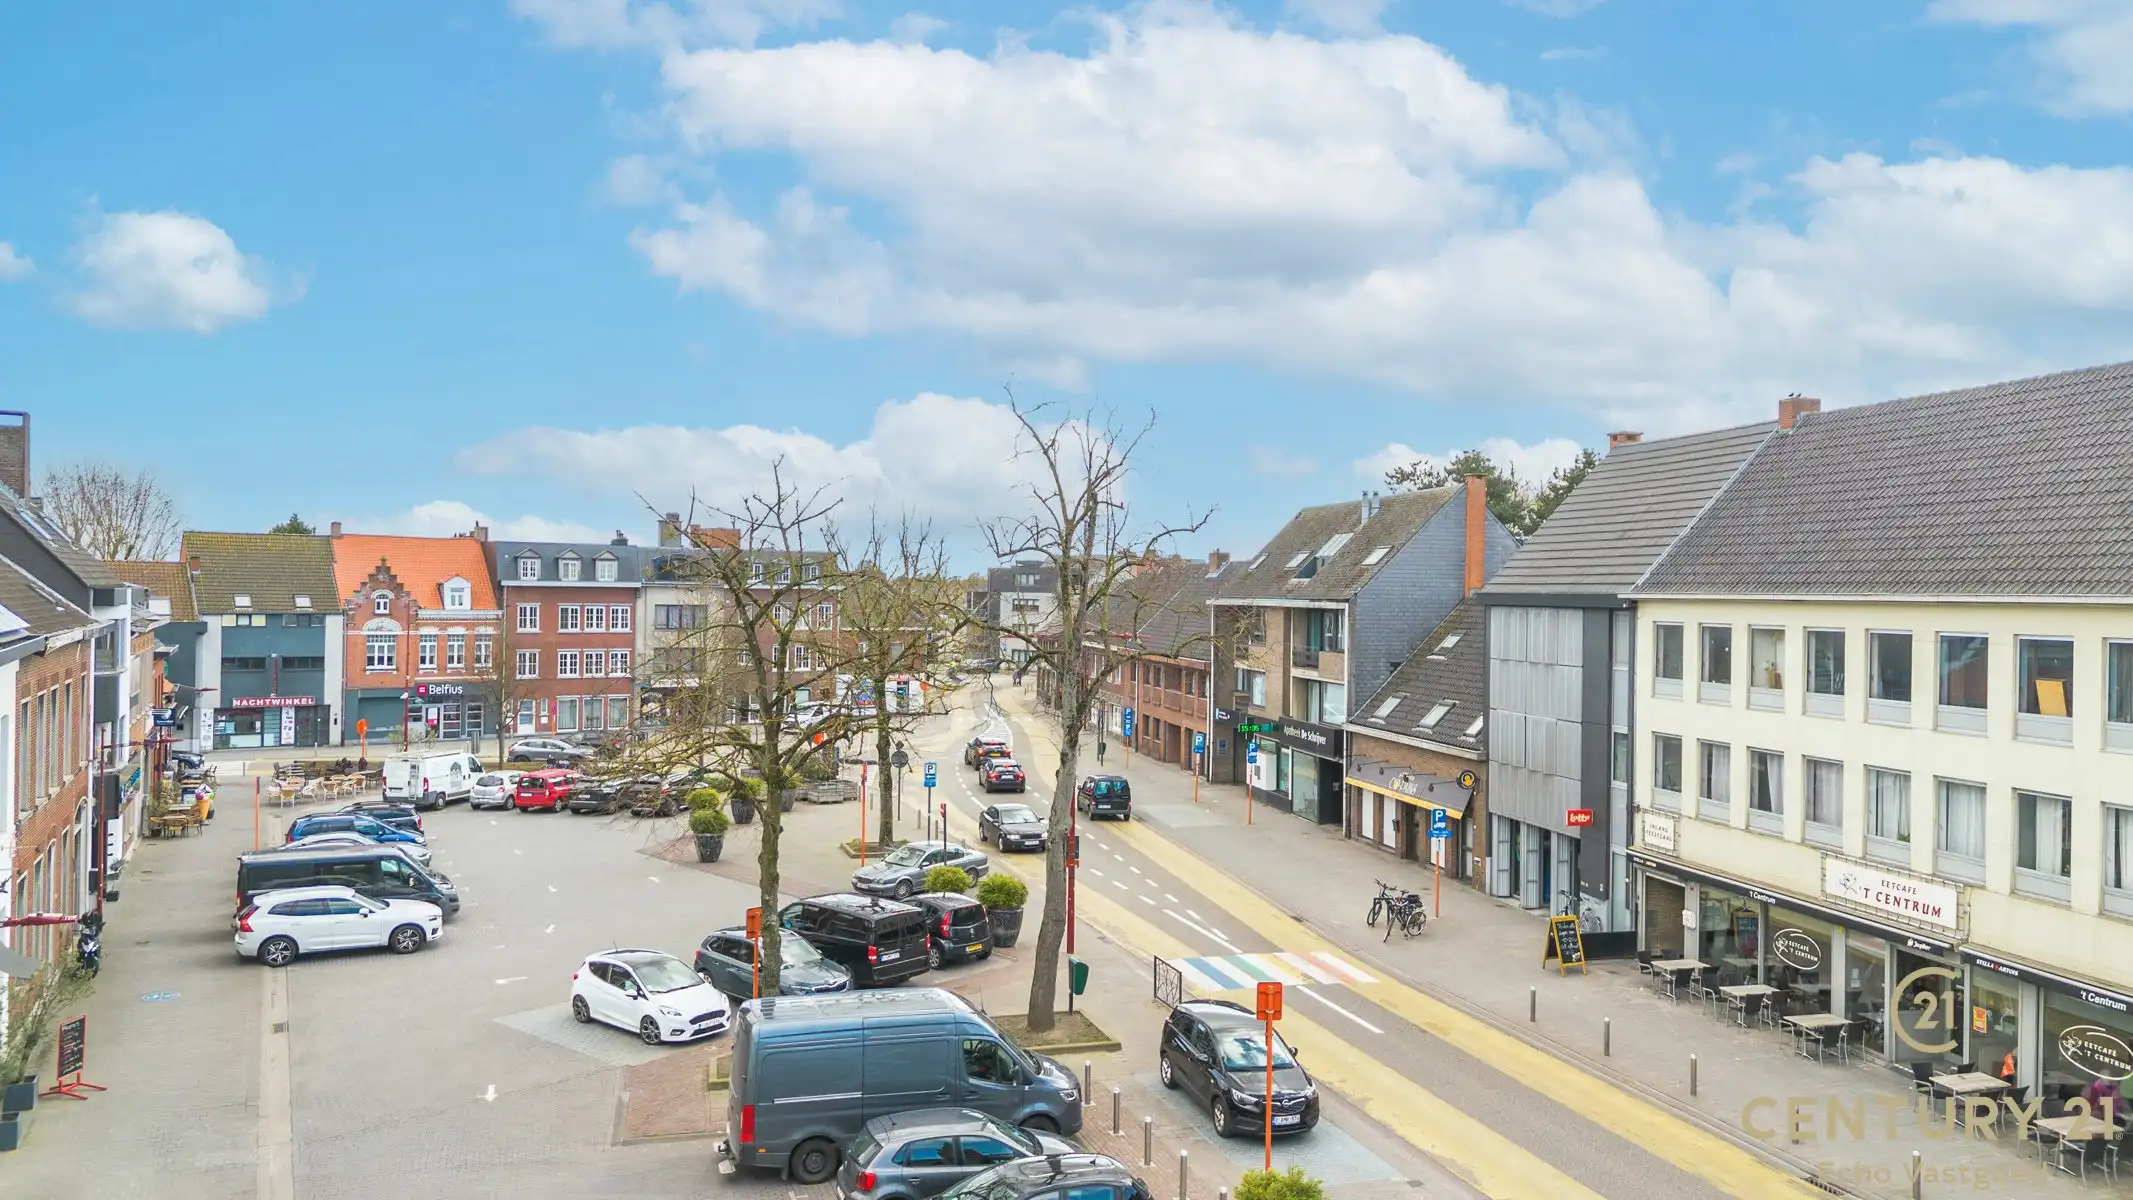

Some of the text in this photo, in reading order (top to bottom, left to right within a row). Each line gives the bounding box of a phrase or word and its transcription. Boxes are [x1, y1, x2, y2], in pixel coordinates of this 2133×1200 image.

[429, 684, 463, 695] Belfius
[233, 697, 315, 707] NACHTWINKEL
[1195, 735, 1203, 746] P
[1435, 810, 1444, 822] P
[1569, 812, 1590, 823] lotto
[1753, 891, 1776, 904] Centrum
[1876, 891, 1942, 918] CENTRUM
[1795, 950, 1818, 962] CENTRUM
[1976, 958, 2019, 977] STELLA ARTOIS
[2087, 993, 2127, 1012] Centrum
[2094, 1055, 2132, 1072] CENTRUM
